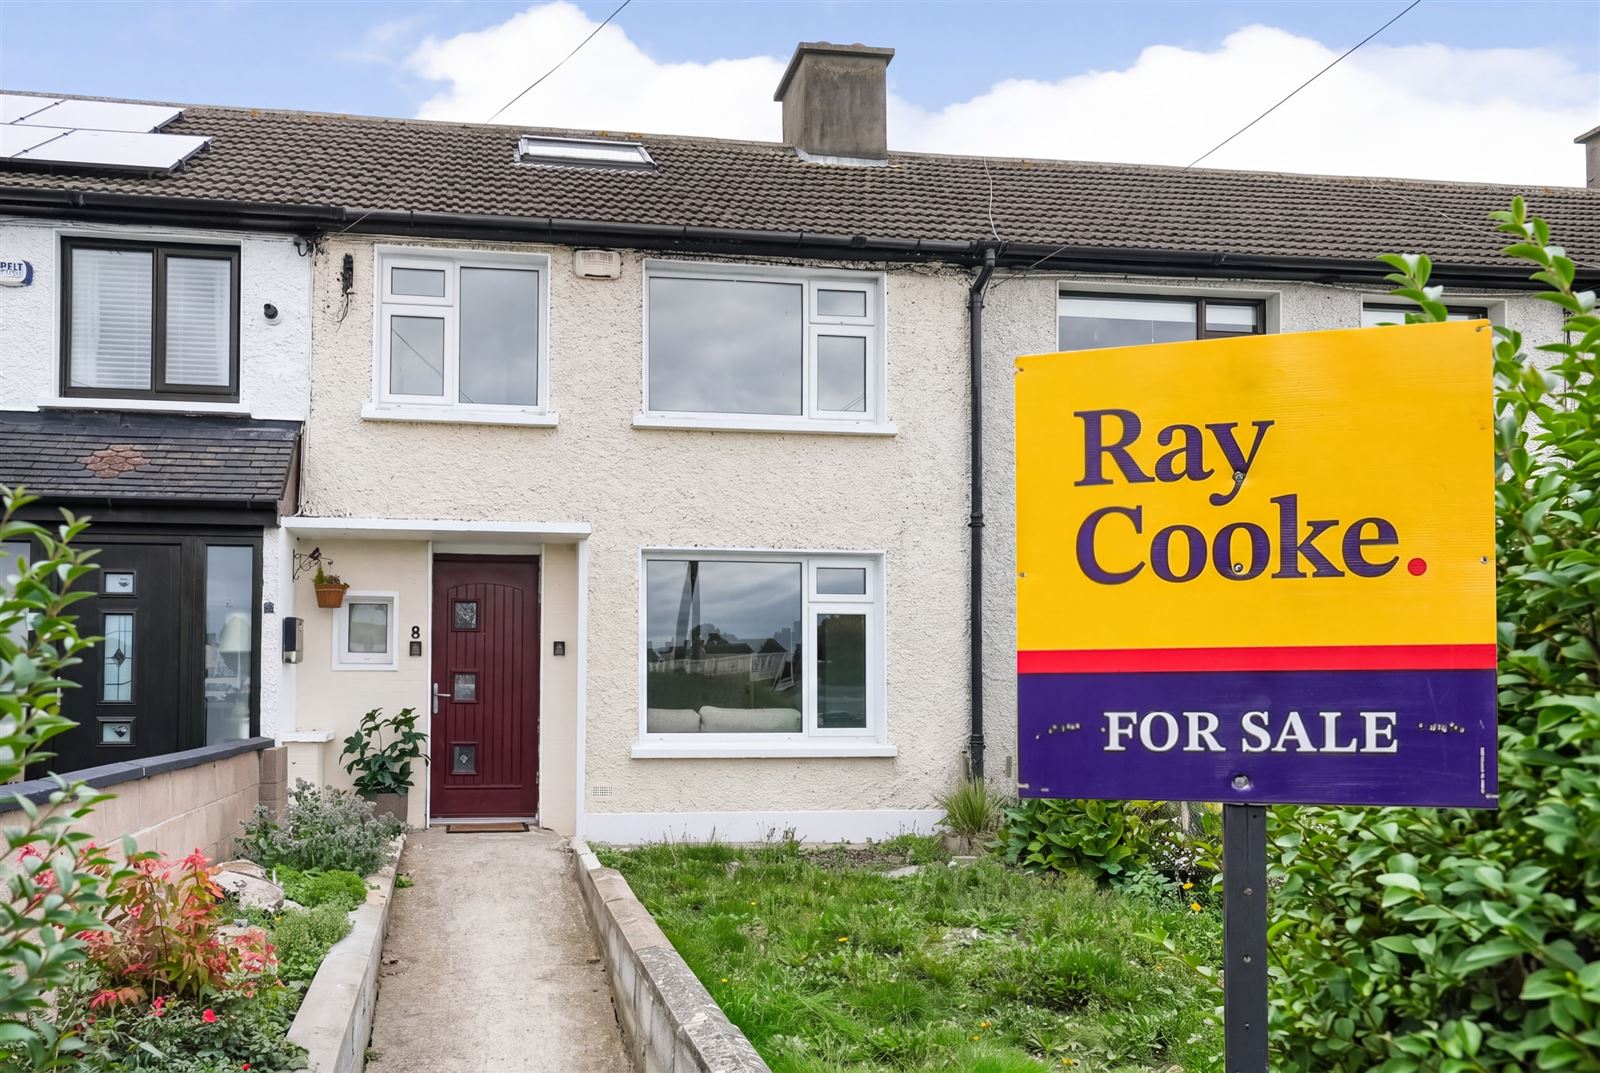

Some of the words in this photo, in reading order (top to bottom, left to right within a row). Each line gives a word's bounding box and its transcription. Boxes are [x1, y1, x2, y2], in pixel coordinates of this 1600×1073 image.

[1074, 408, 1275, 507] Ray
[1076, 494, 1428, 586] Cooke.
[411, 625, 420, 640] 8
[1104, 711, 1226, 752] FOR
[1241, 711, 1398, 753] SALE
